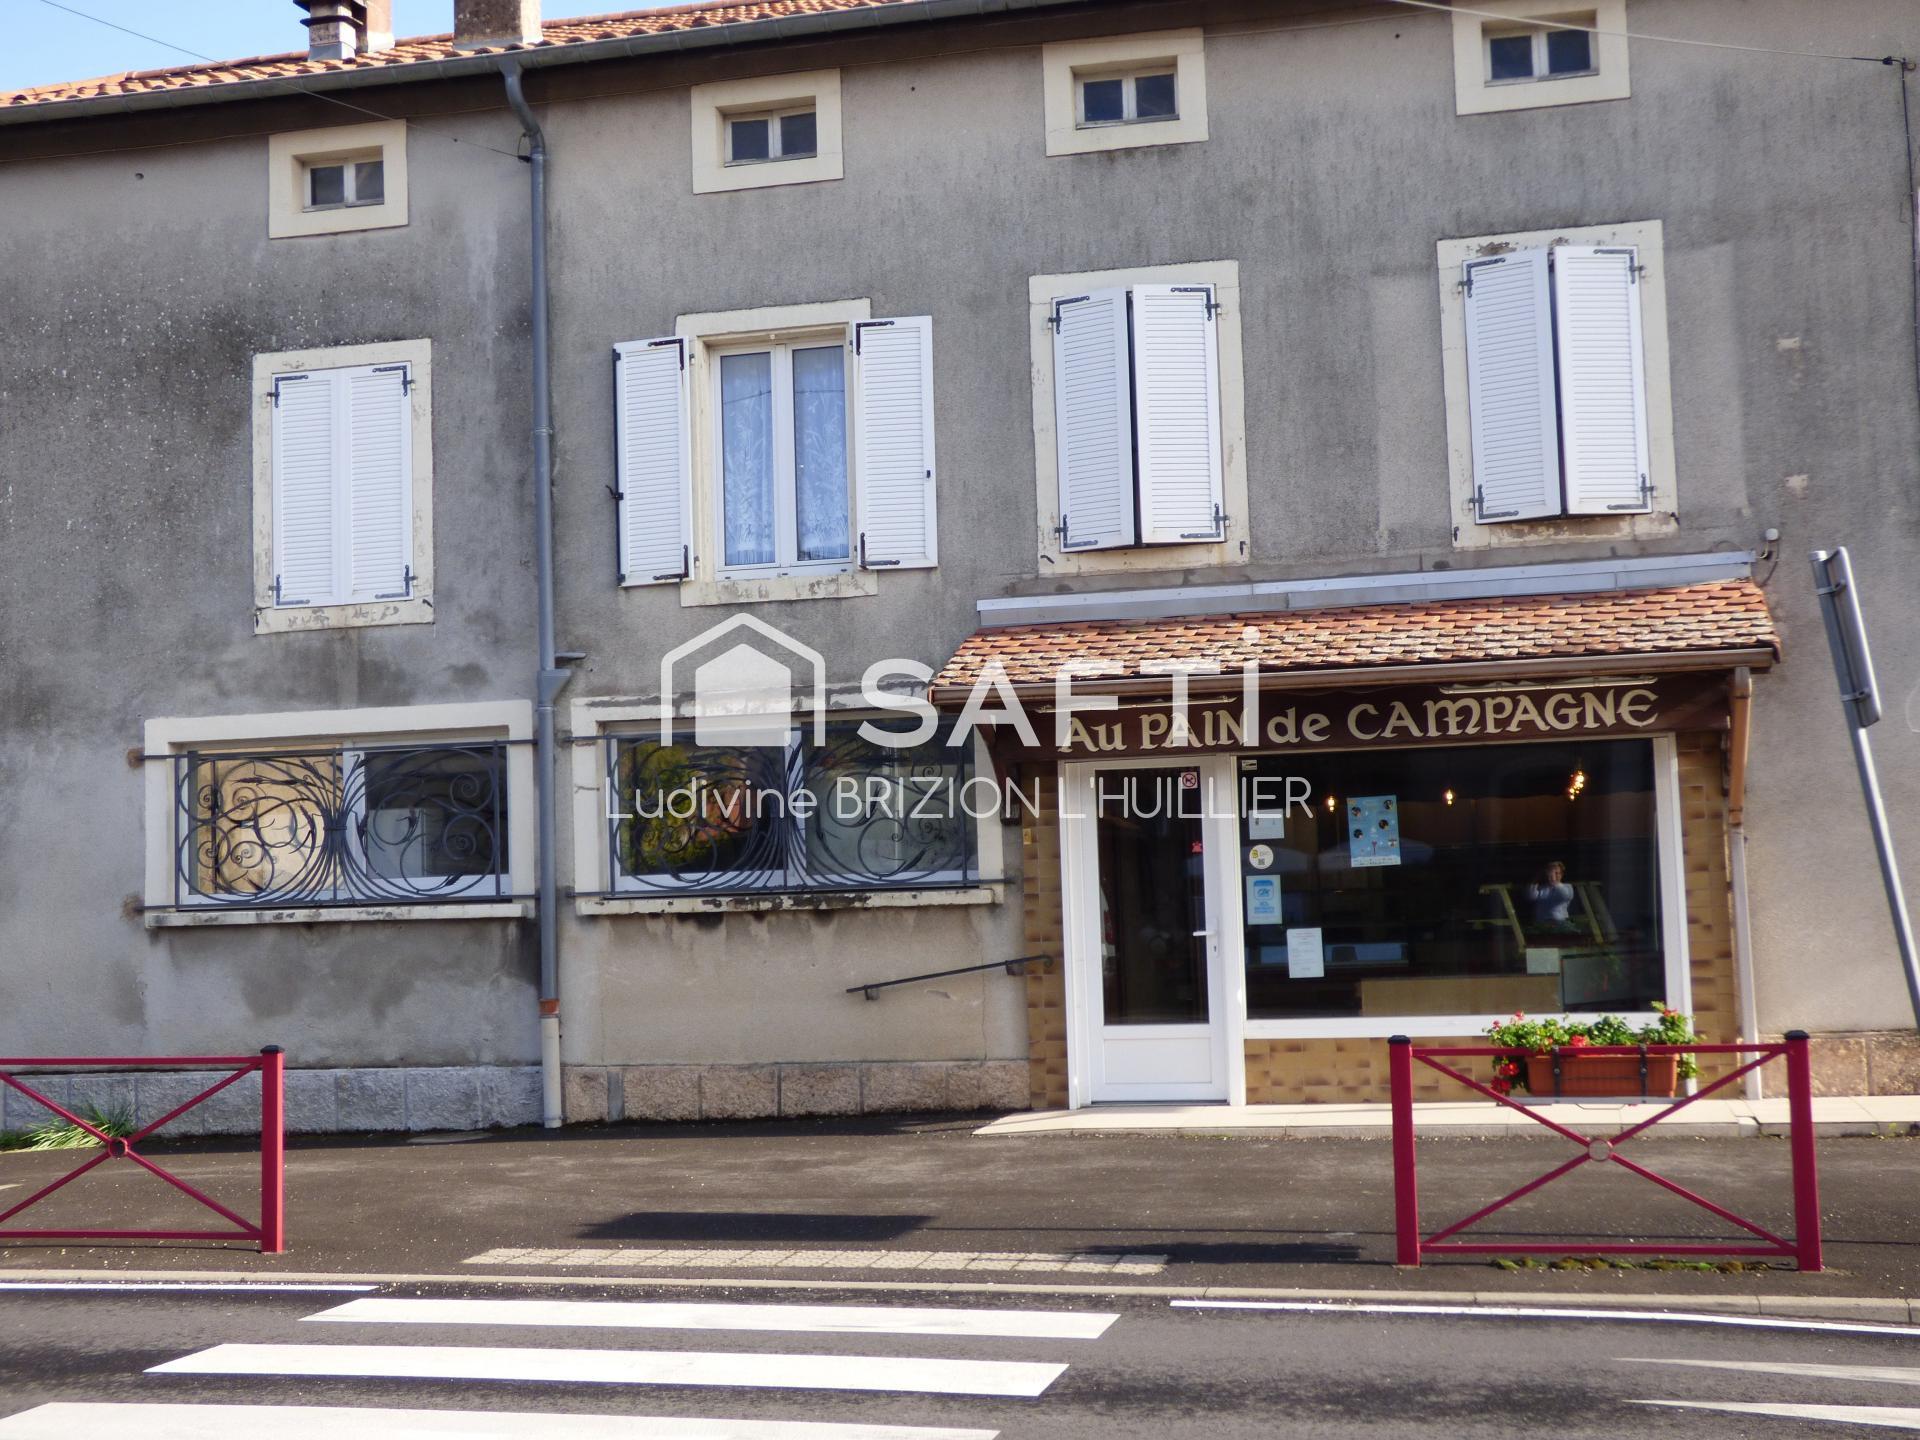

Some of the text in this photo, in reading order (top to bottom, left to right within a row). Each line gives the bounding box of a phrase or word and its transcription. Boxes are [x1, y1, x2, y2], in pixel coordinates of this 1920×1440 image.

[1058, 688, 1659, 753] Au PAIN de CAMPAGNE
